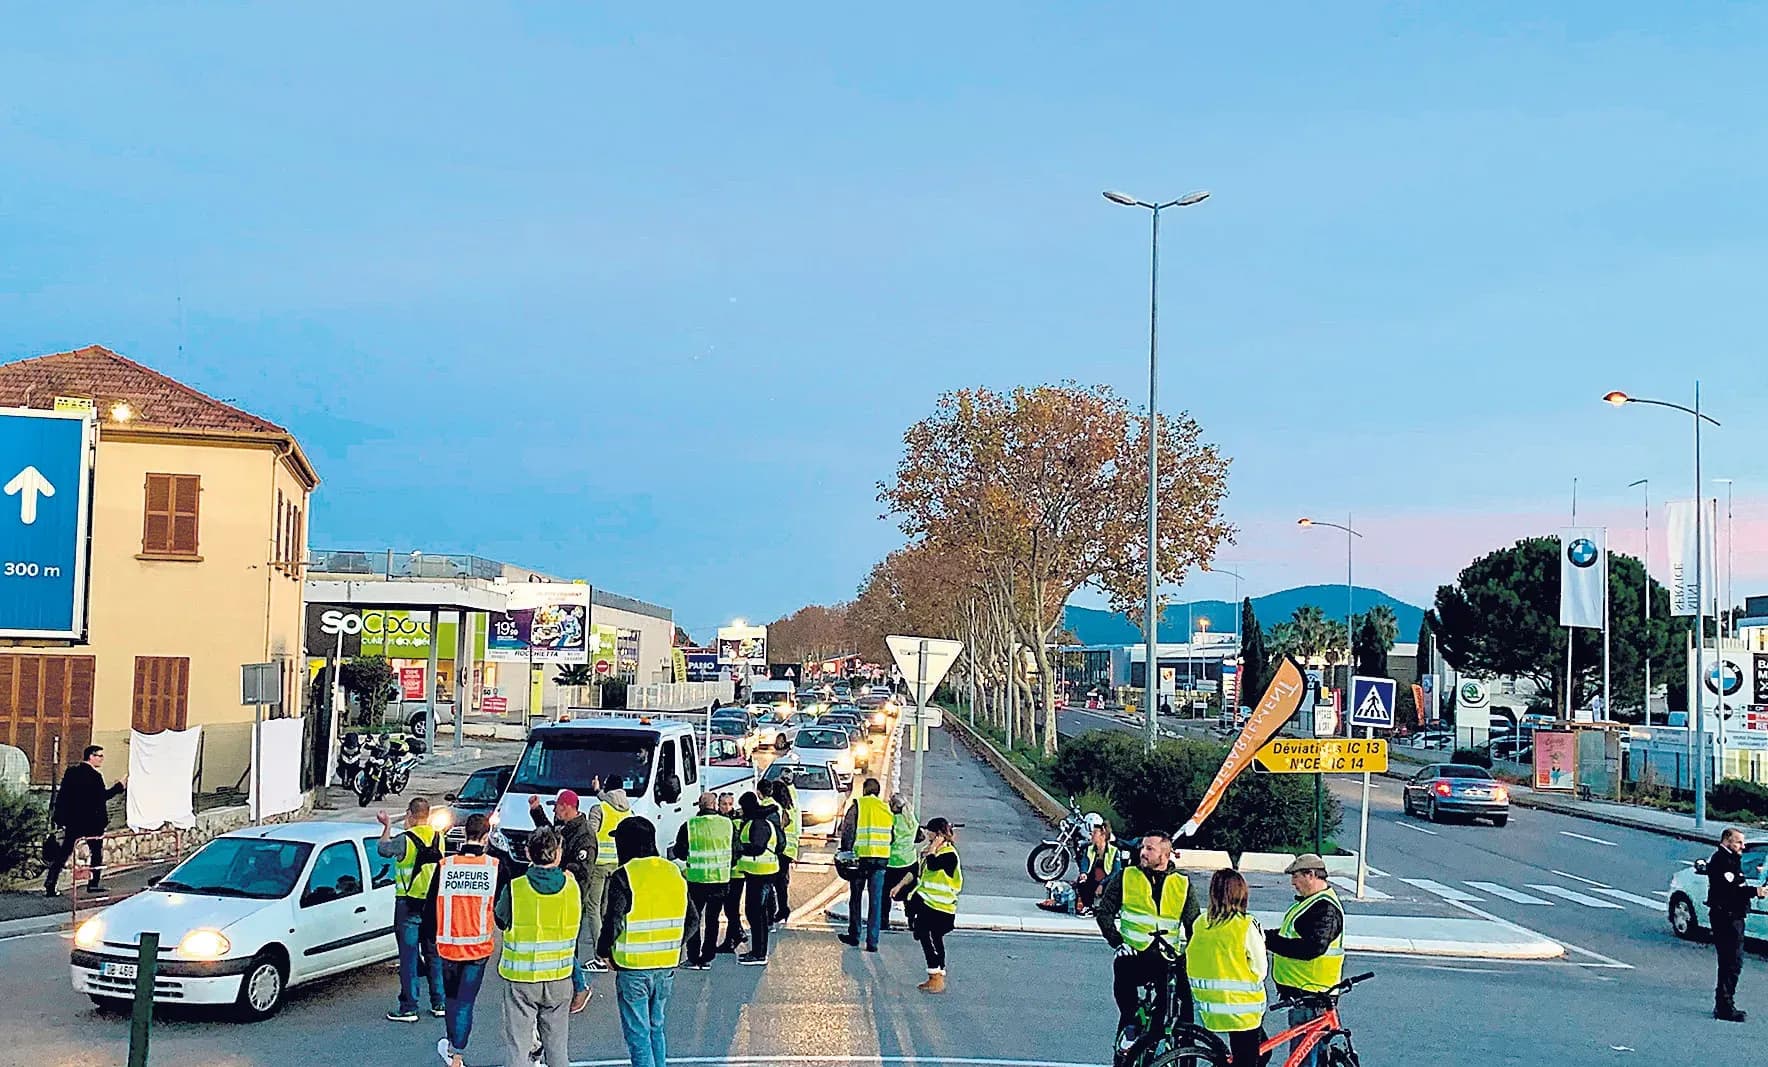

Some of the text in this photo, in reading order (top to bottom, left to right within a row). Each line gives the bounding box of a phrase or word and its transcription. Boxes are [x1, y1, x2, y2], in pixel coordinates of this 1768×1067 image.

[4, 562, 60, 577] 300 m
[1366, 742, 1380, 754] 13
[1351, 757, 1364, 769] 14
[447, 871, 489, 881] SAPEURS
[445, 881, 490, 891] POMPIERS
